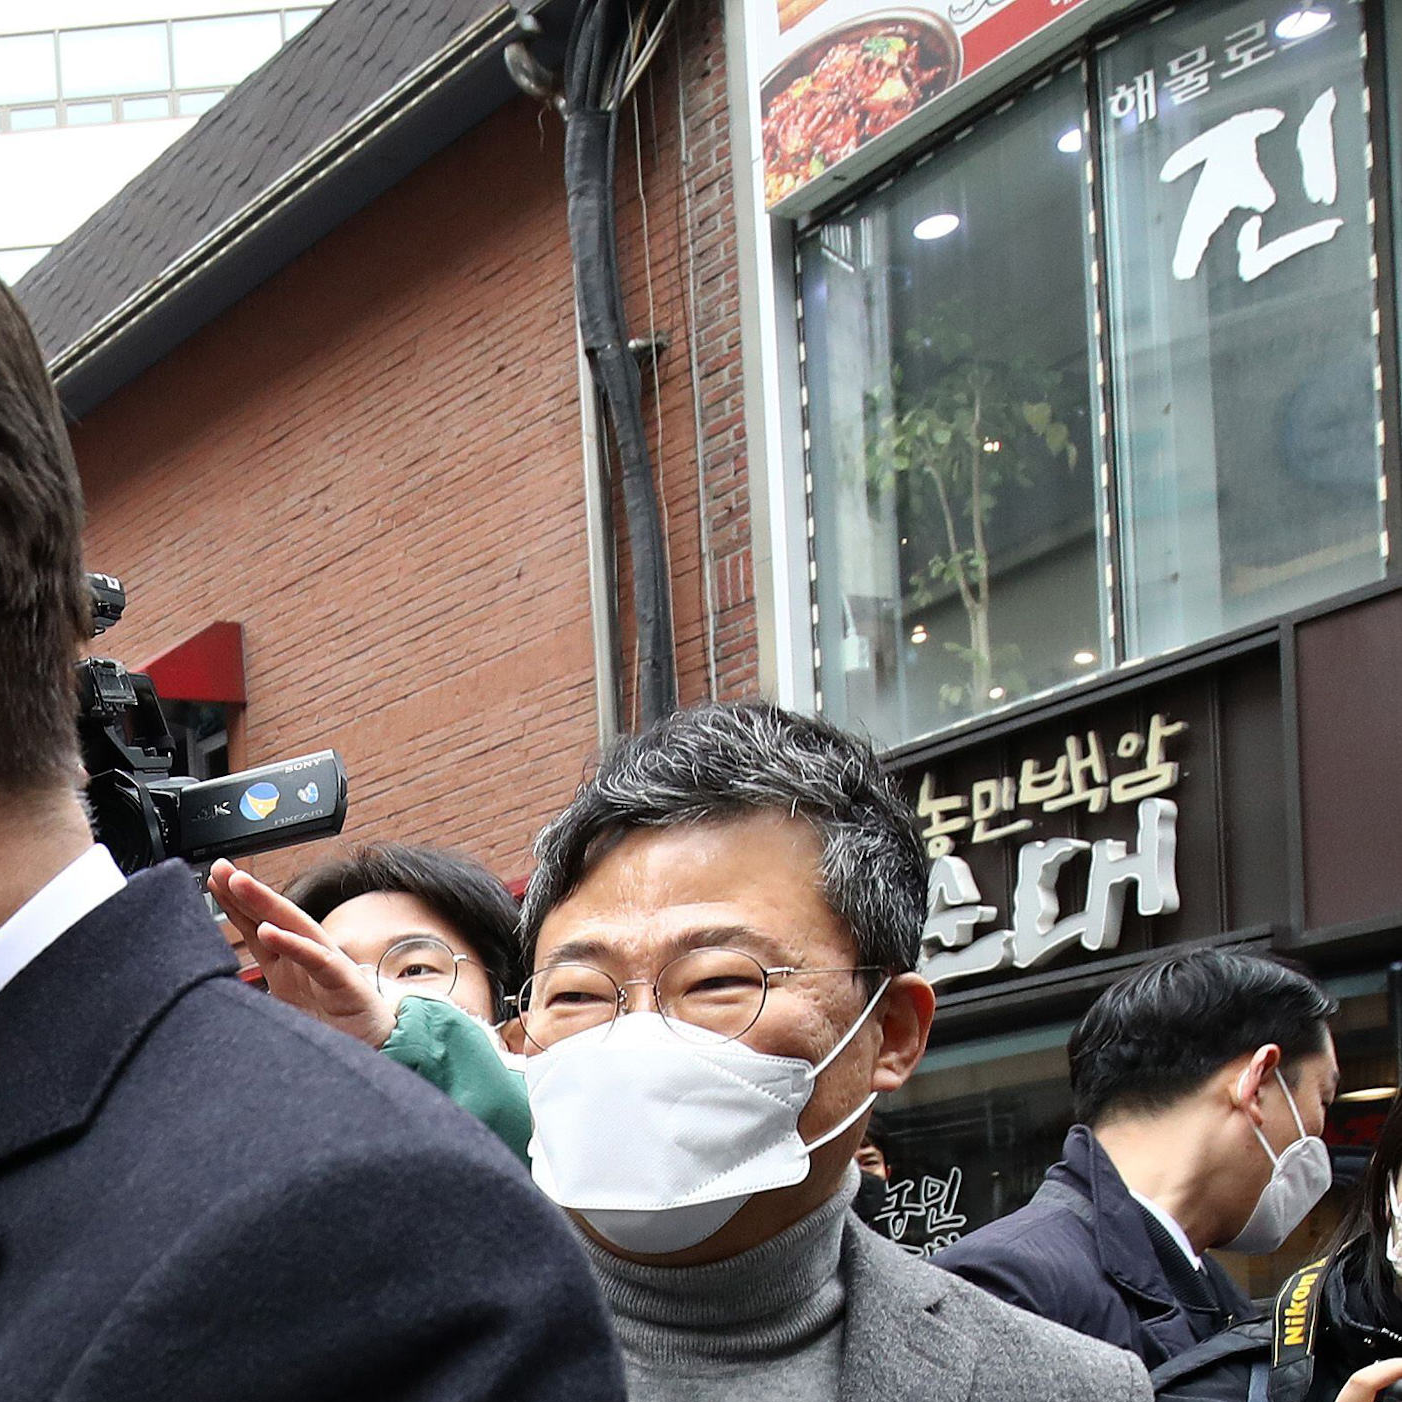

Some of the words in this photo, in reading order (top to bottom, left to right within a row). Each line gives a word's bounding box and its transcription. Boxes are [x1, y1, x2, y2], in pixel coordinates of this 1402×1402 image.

[1159, 86, 1345, 283] 진
[284, 757, 322, 775] SONY
[915, 712, 1190, 860] 농민백암
[1283, 1272, 1319, 1346] Nikon
